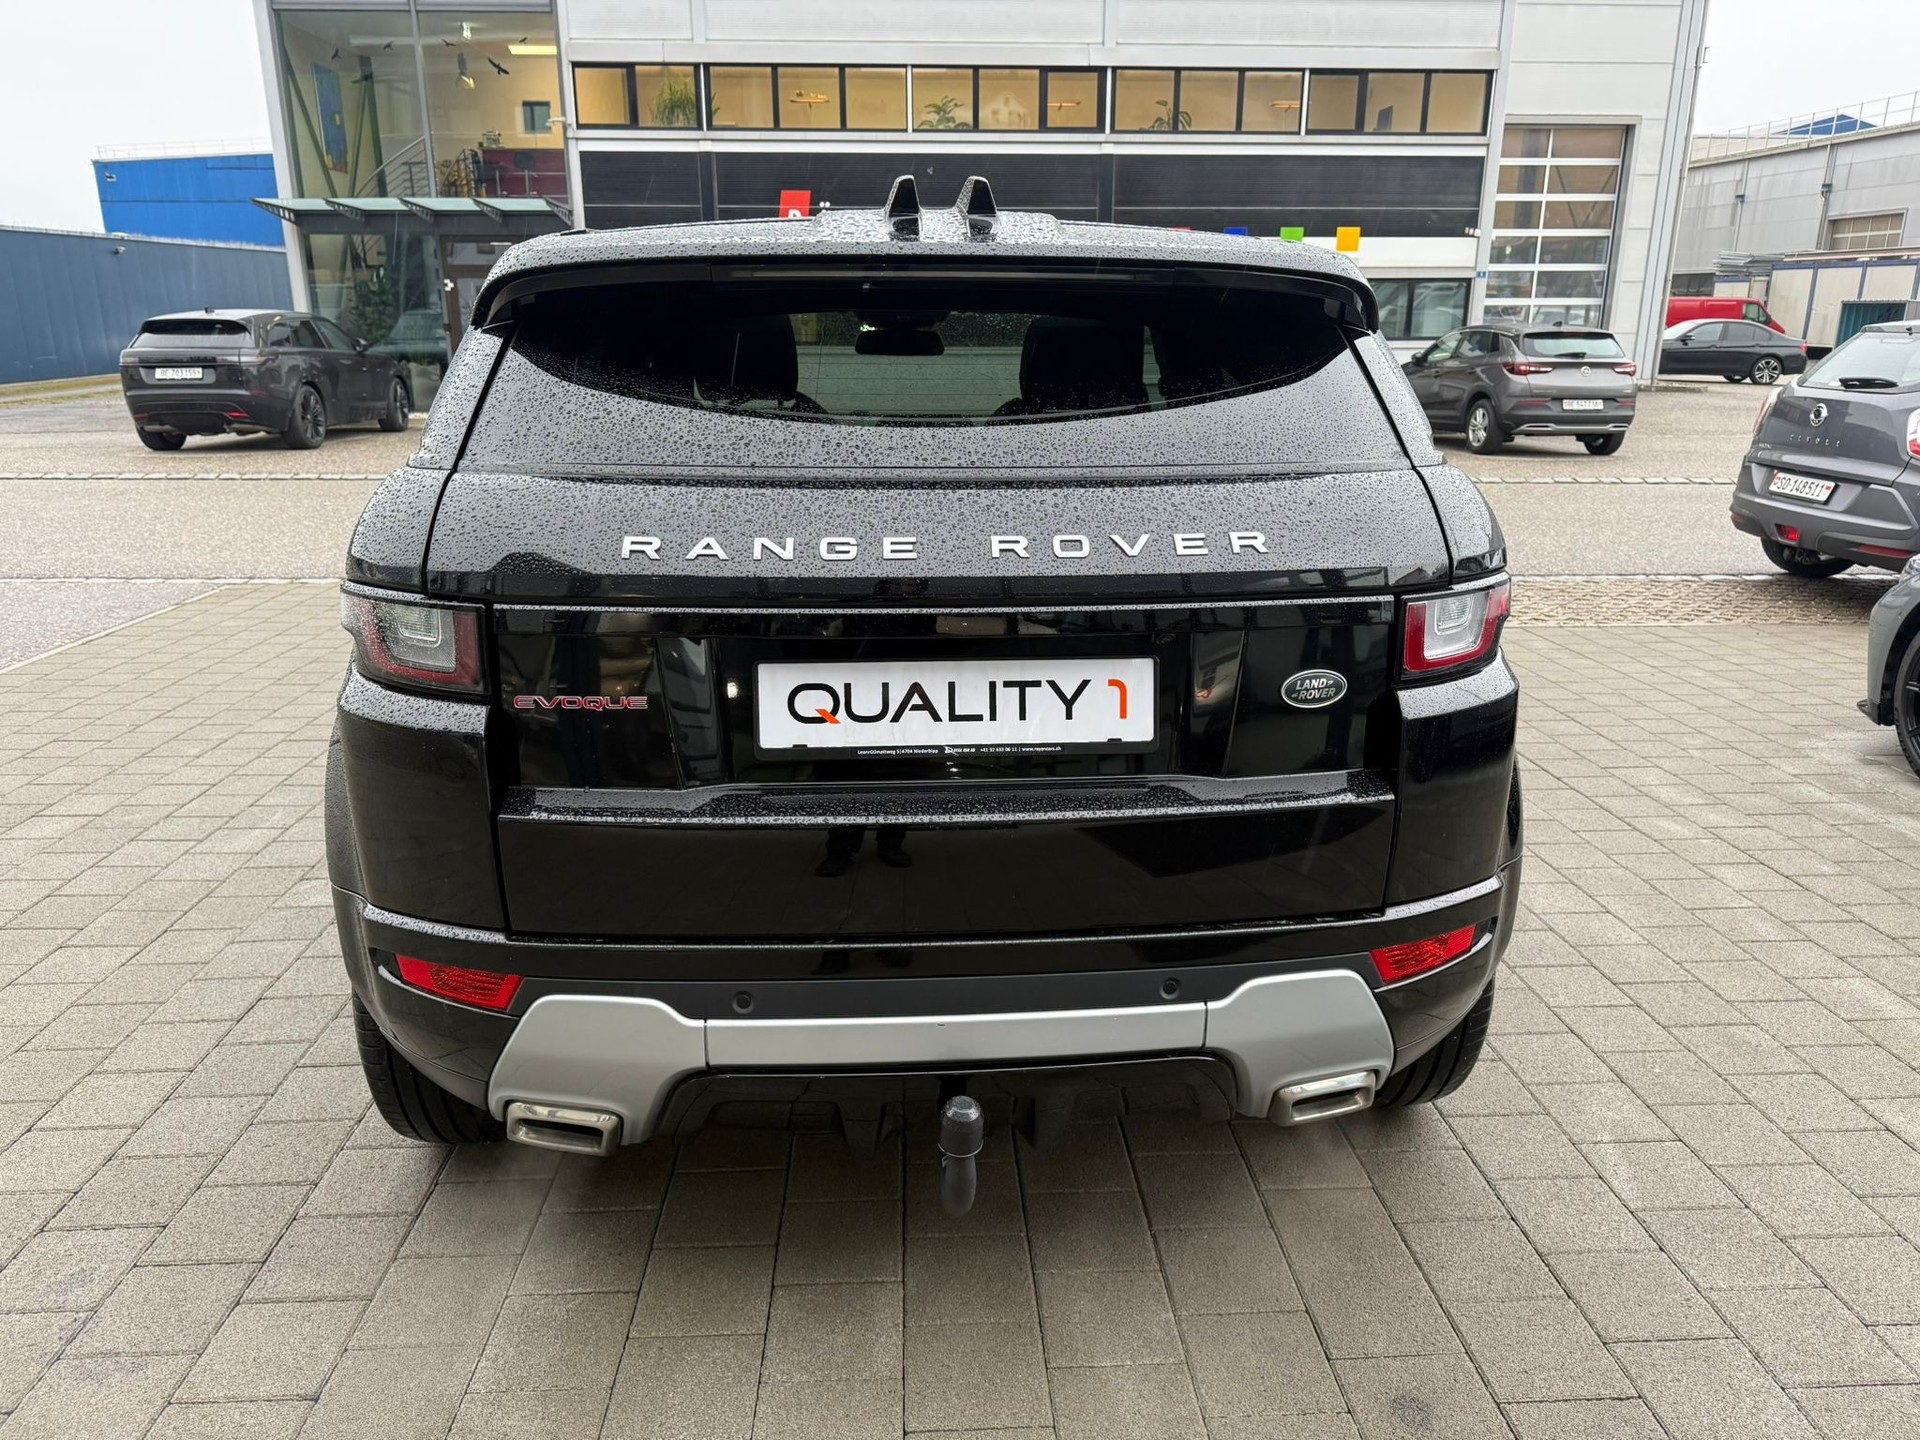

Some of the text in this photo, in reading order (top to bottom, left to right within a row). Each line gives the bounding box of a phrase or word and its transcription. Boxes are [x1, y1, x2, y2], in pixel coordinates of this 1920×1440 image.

[621, 531, 1269, 561] RANGE ROVER
[1295, 678, 1327, 691] LAND
[787, 679, 1127, 724] QUALITY 1
[1298, 687, 1336, 700] ROVER
[513, 695, 648, 711] EVOQUE
